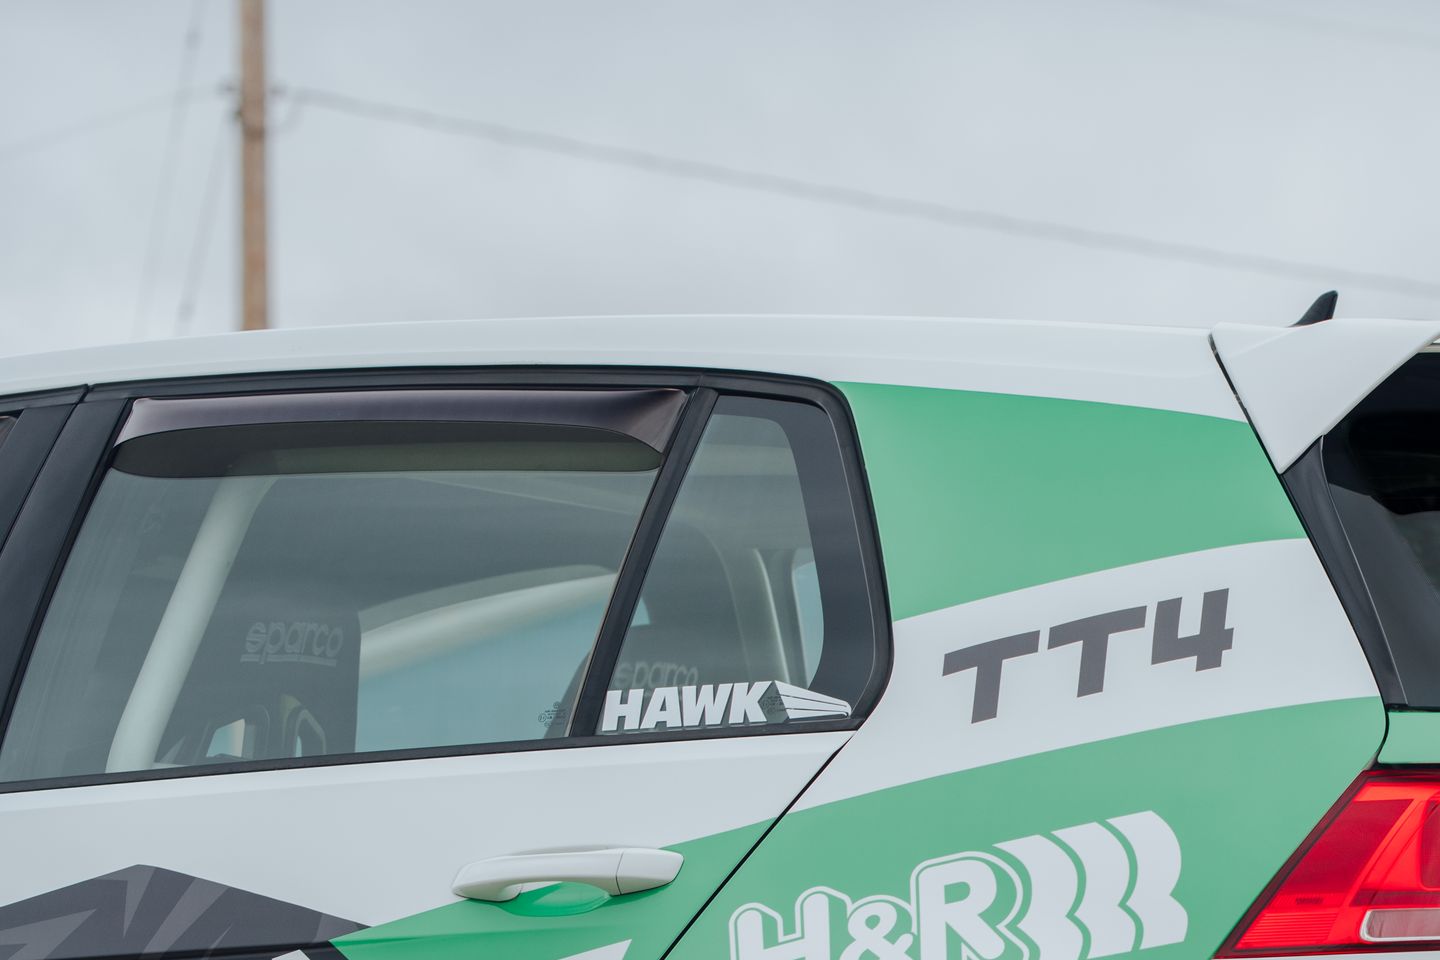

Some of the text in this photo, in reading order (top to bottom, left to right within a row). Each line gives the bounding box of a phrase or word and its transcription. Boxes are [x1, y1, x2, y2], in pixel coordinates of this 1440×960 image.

[246, 622, 344, 664] sparco
[942, 587, 1234, 723] TT4
[602, 681, 772, 731] HAWK
